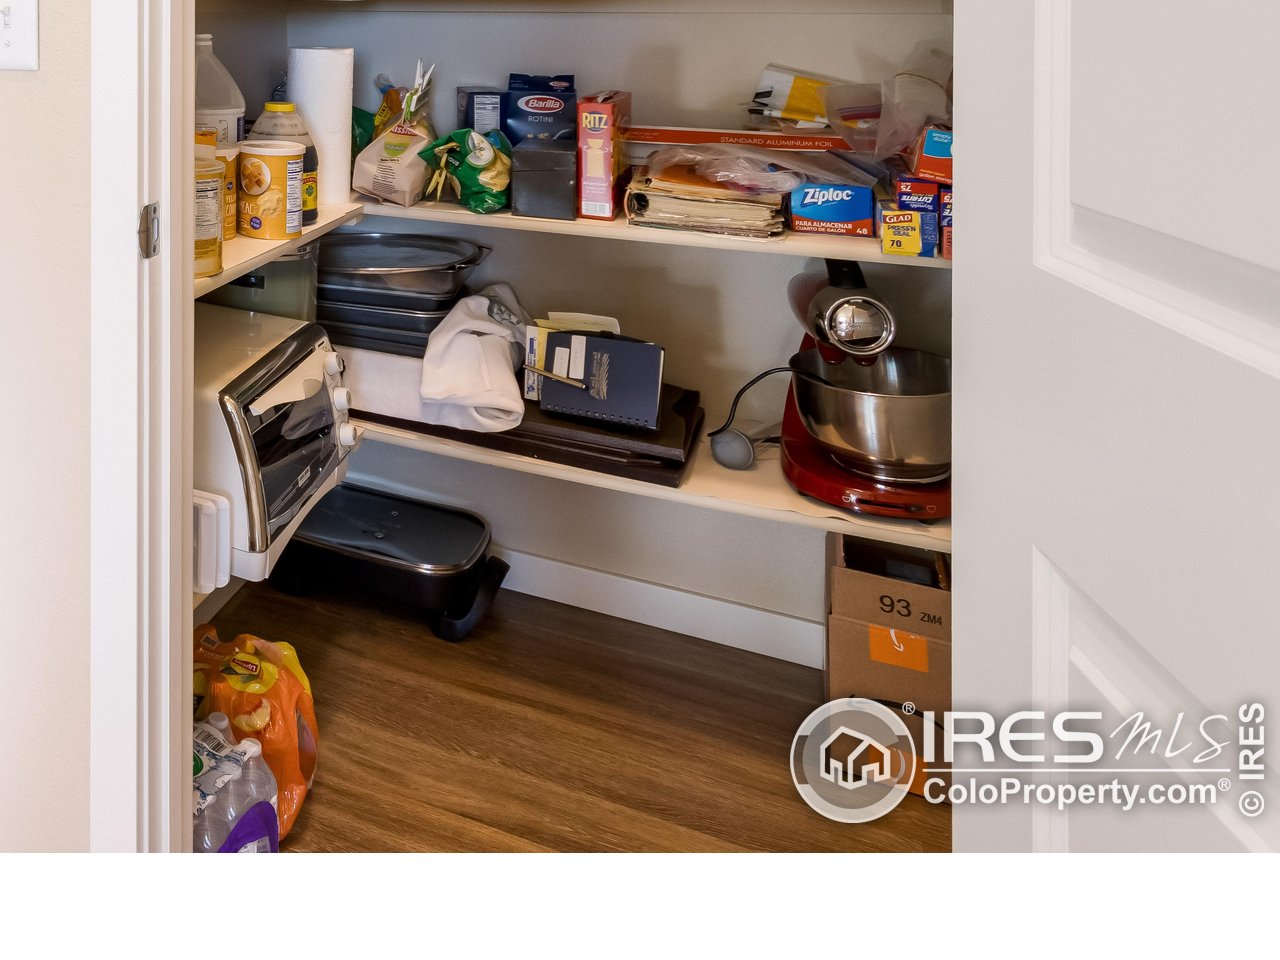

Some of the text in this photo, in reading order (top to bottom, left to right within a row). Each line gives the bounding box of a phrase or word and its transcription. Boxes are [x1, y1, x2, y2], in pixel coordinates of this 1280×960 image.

[528, 99, 560, 109] Barilla
[582, 112, 608, 130] RITZ
[720, 136, 764, 145] STANDARD
[765, 139, 813, 147] ALUMINUM
[804, 188, 852, 204] Ziploc
[885, 214, 912, 223] GLAD
[812, 221, 853, 229] ALMACENAR
[856, 227, 868, 235] 48
[890, 239, 902, 248] 70
[879, 594, 943, 626] 93 ZM4
